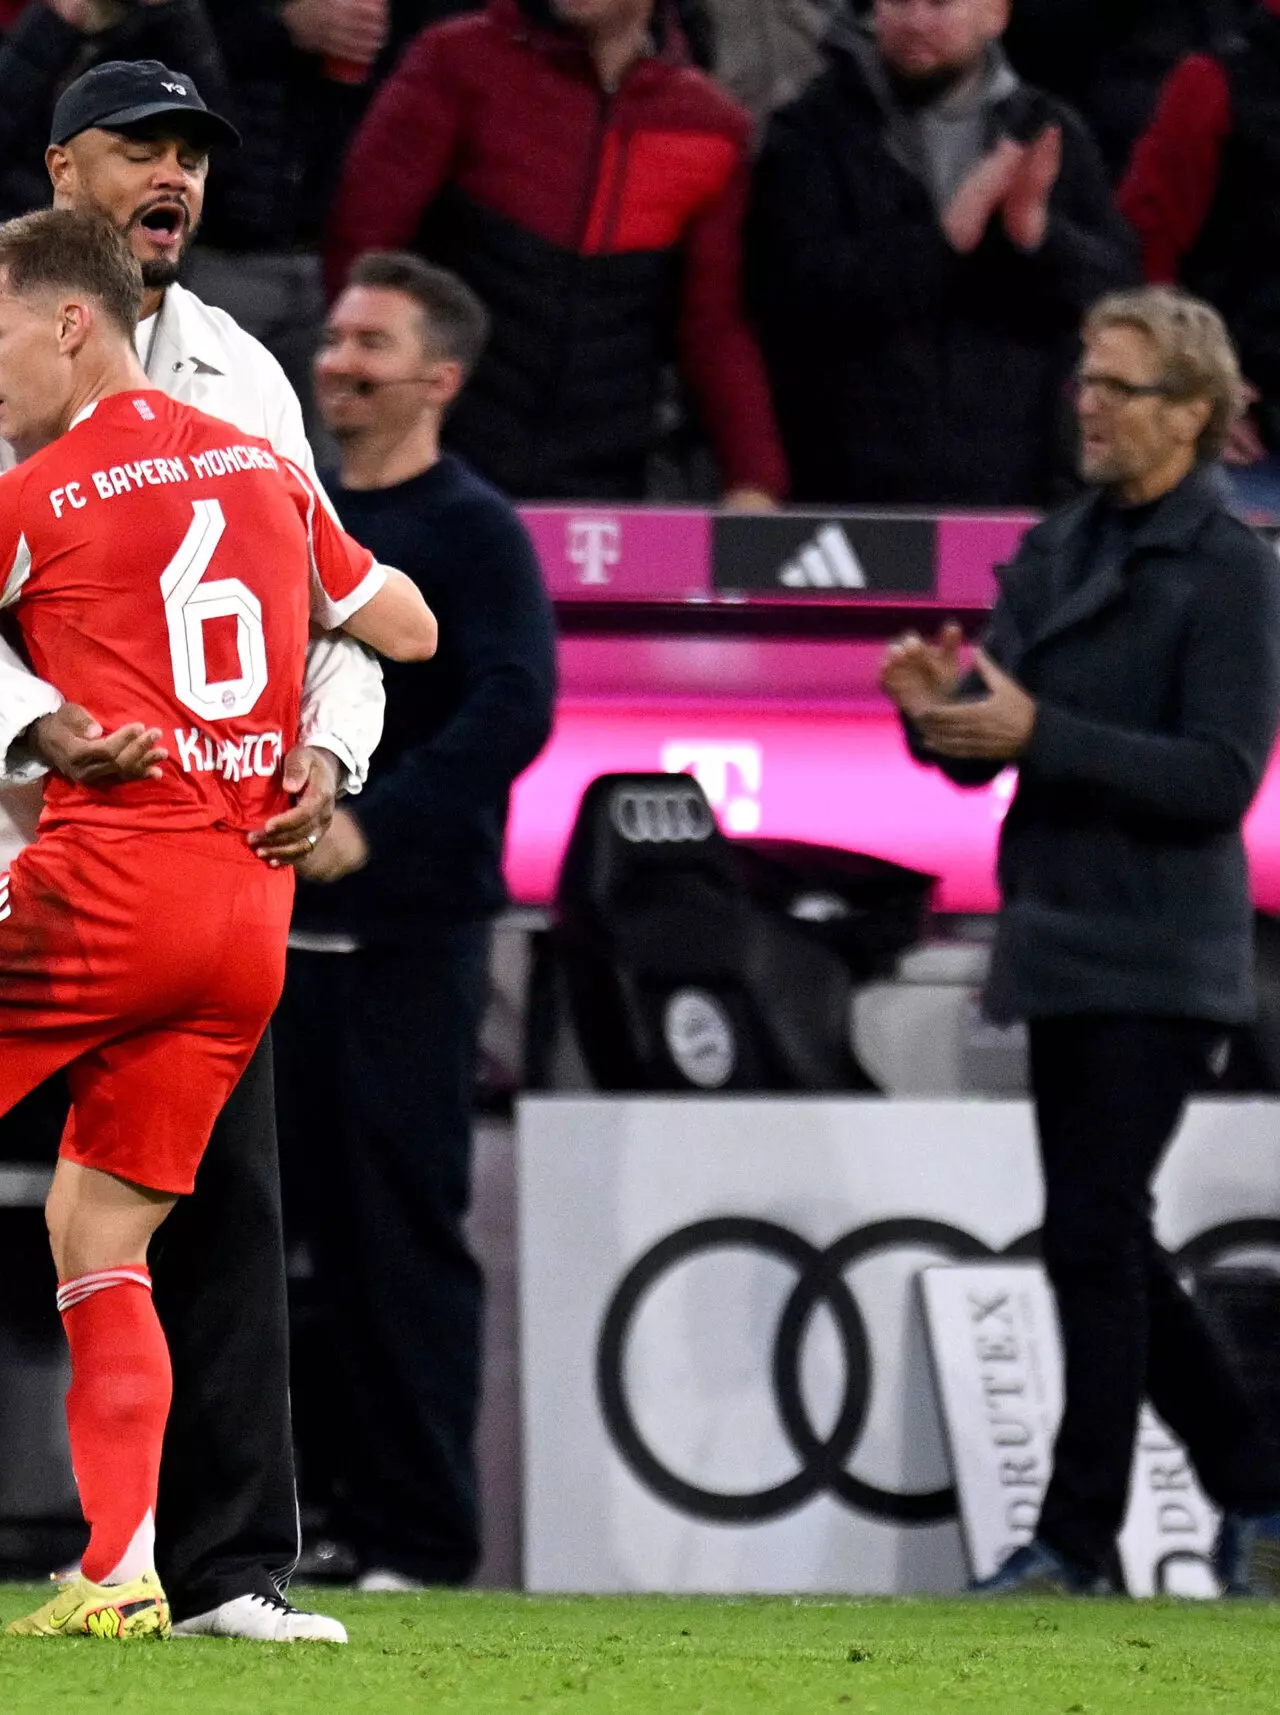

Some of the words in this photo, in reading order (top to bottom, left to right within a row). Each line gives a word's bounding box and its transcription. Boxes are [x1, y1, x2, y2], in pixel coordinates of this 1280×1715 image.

[160, 81, 187, 96] Y-3
[49, 481, 87, 518] FC
[91, 456, 189, 500] BAYERN
[159, 498, 269, 722] 6
[967, 1293, 1041, 1531] DRUTEX
